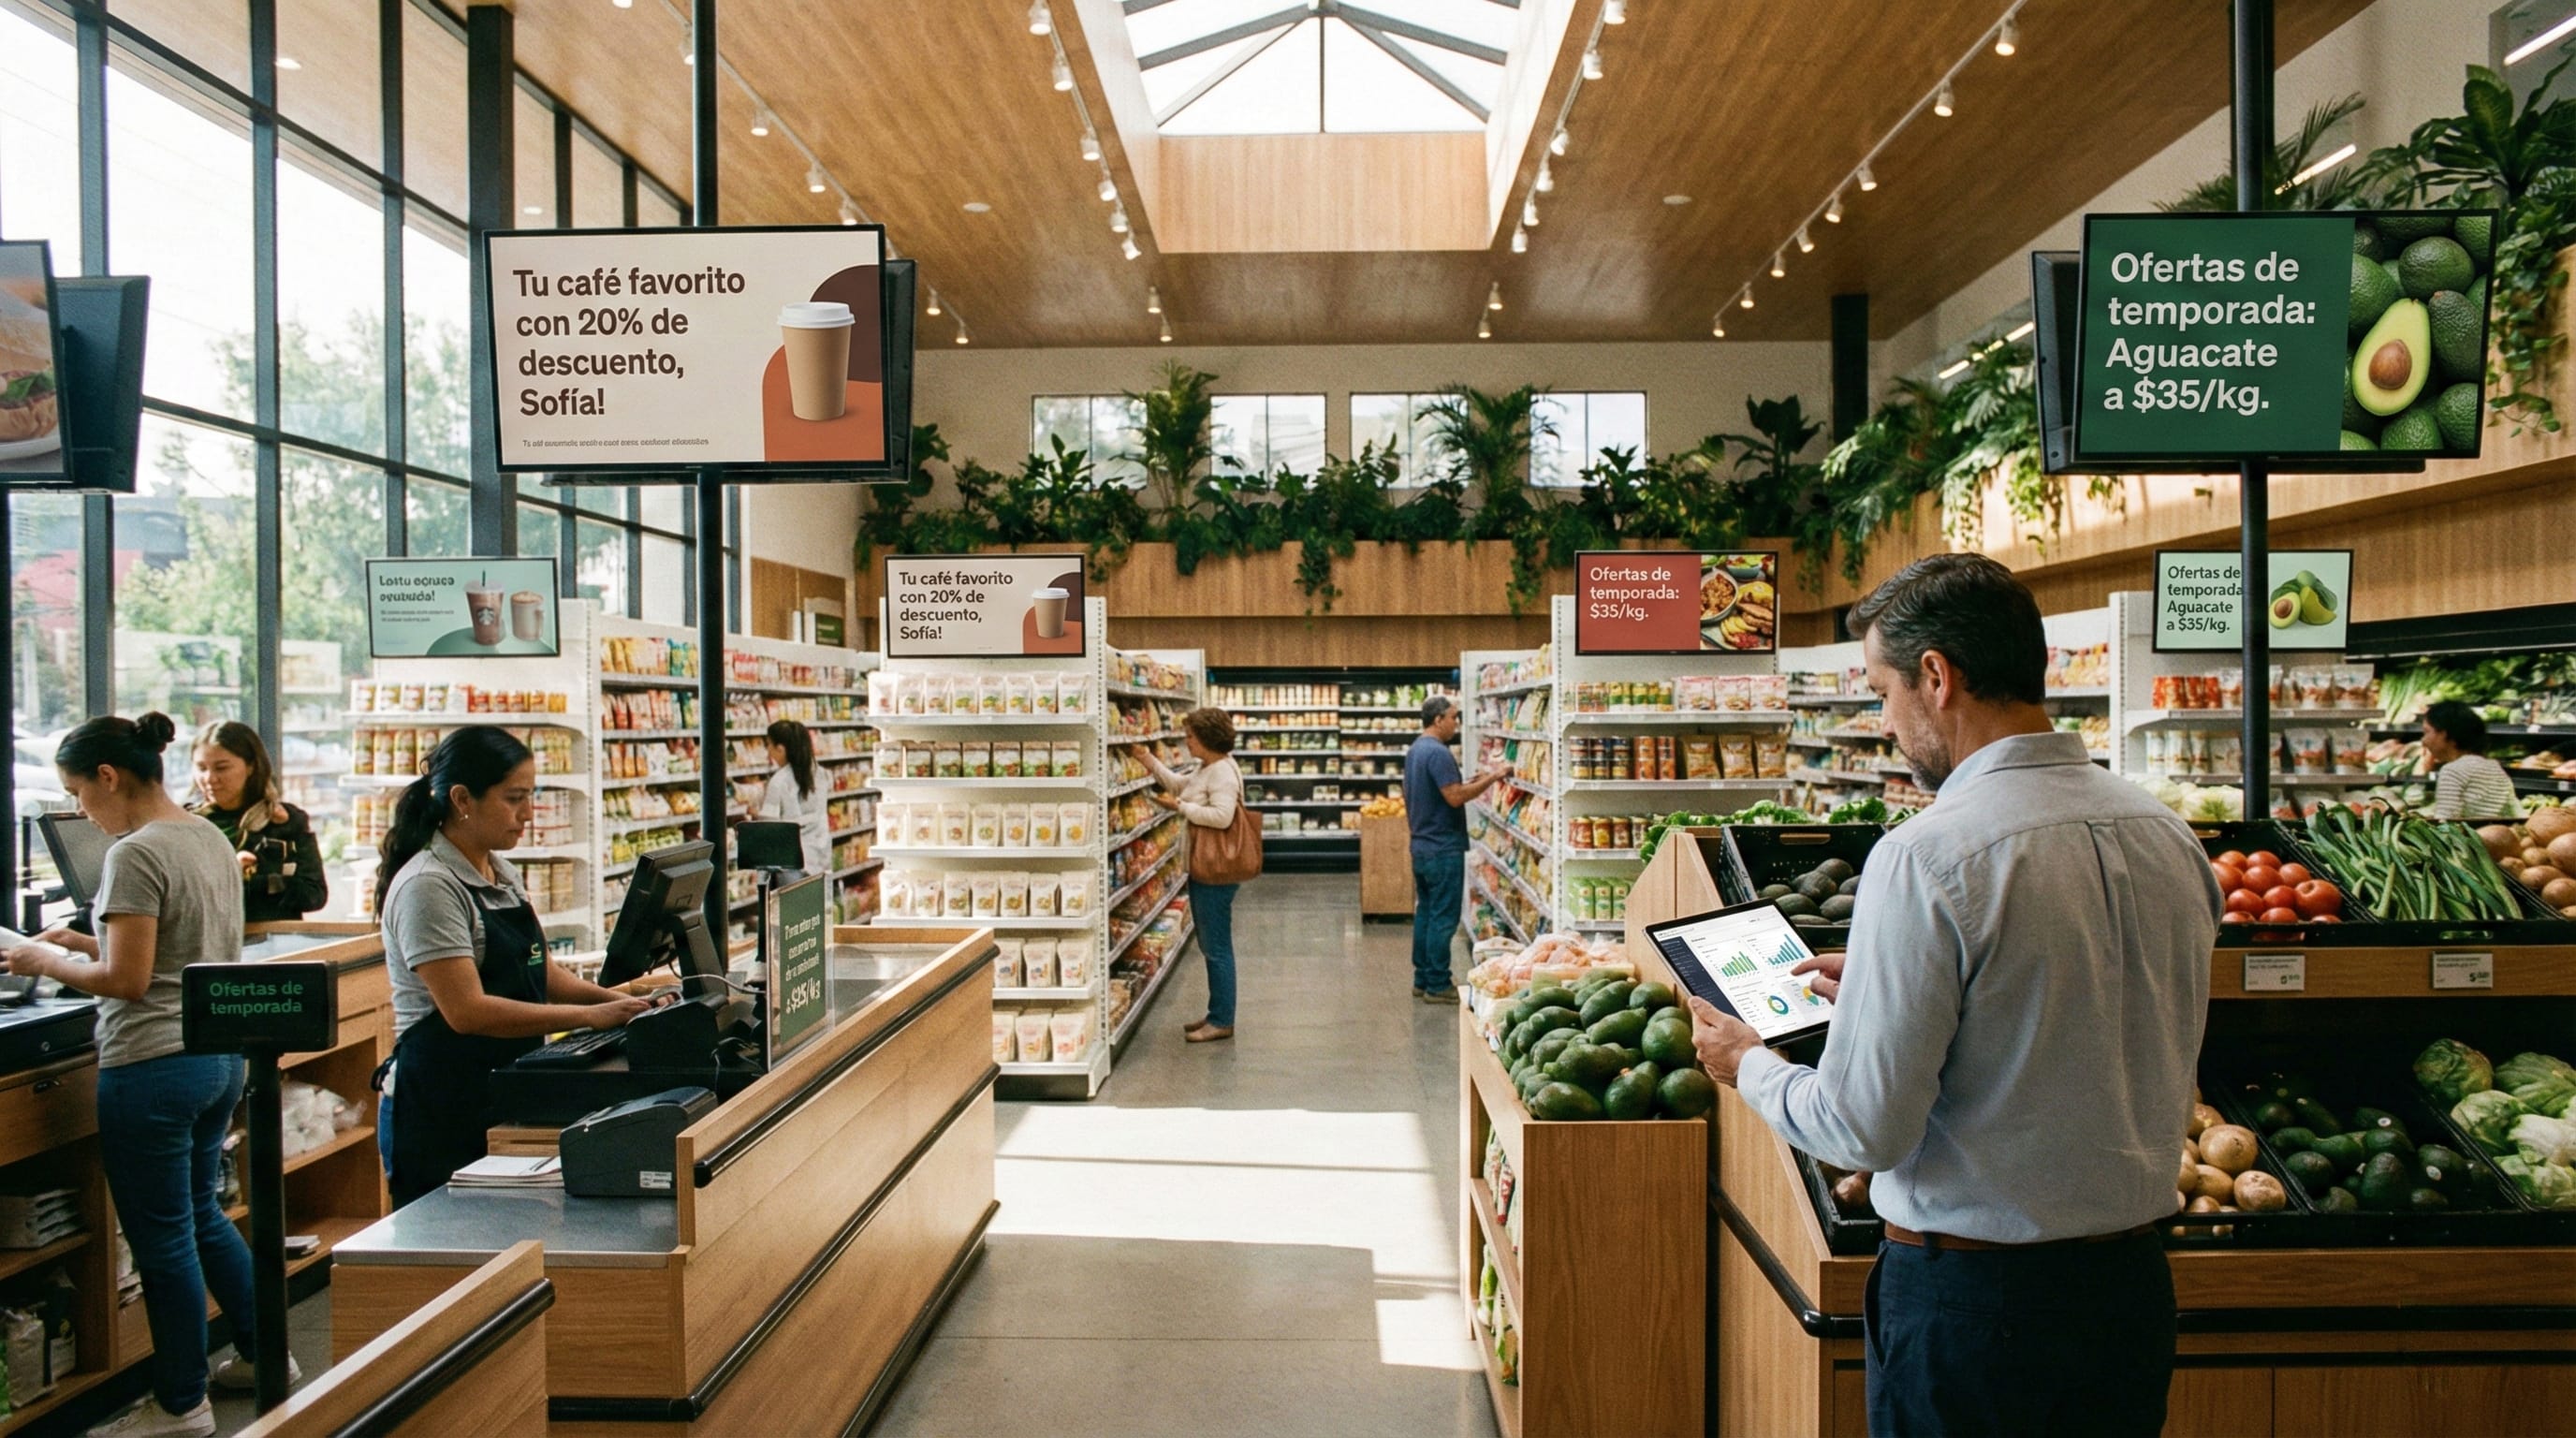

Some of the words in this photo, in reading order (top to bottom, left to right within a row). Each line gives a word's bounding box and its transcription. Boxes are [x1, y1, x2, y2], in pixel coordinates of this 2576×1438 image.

[2112, 253, 2245, 282] Ofertas
[2255, 252, 2299, 281] de
[513, 270, 549, 297] Tu
[558, 268, 621, 296] café
[628, 267, 744, 294] favorito
[2109, 295, 2315, 330] temporada:
[517, 315, 569, 336] con
[578, 308, 643, 335] 20%
[651, 308, 688, 334] de
[520, 349, 683, 378] descuento,
[2106, 338, 2277, 374] Aguacate
[520, 389, 604, 416] Sofía!
[2104, 388, 2124, 409] a
[2132, 376, 2268, 416] $35/kg.
[899, 572, 916, 585] Tu
[921, 571, 952, 584] café
[956, 571, 1013, 584] favorito
[1590, 566, 1647, 580] Ofertas
[1652, 567, 1671, 580] de
[2168, 565, 2219, 579] Ofertas
[2224, 566, 2240, 579] de
[900, 594, 926, 603] con
[930, 590, 962, 603] 20%
[966, 590, 984, 603] de
[1590, 584, 1678, 603] temporada:
[900, 608, 981, 623] descuento,
[1590, 603, 1648, 621] $35/kg.
[2167, 600, 2232, 617] Aguacate
[900, 626, 942, 639] Sofía!
[2167, 622, 2174, 630] a
[2179, 616, 2230, 633] $35/kg.
[210, 982, 276, 996] Ofertas
[282, 981, 302, 994] de
[211, 999, 301, 1017] temporada
